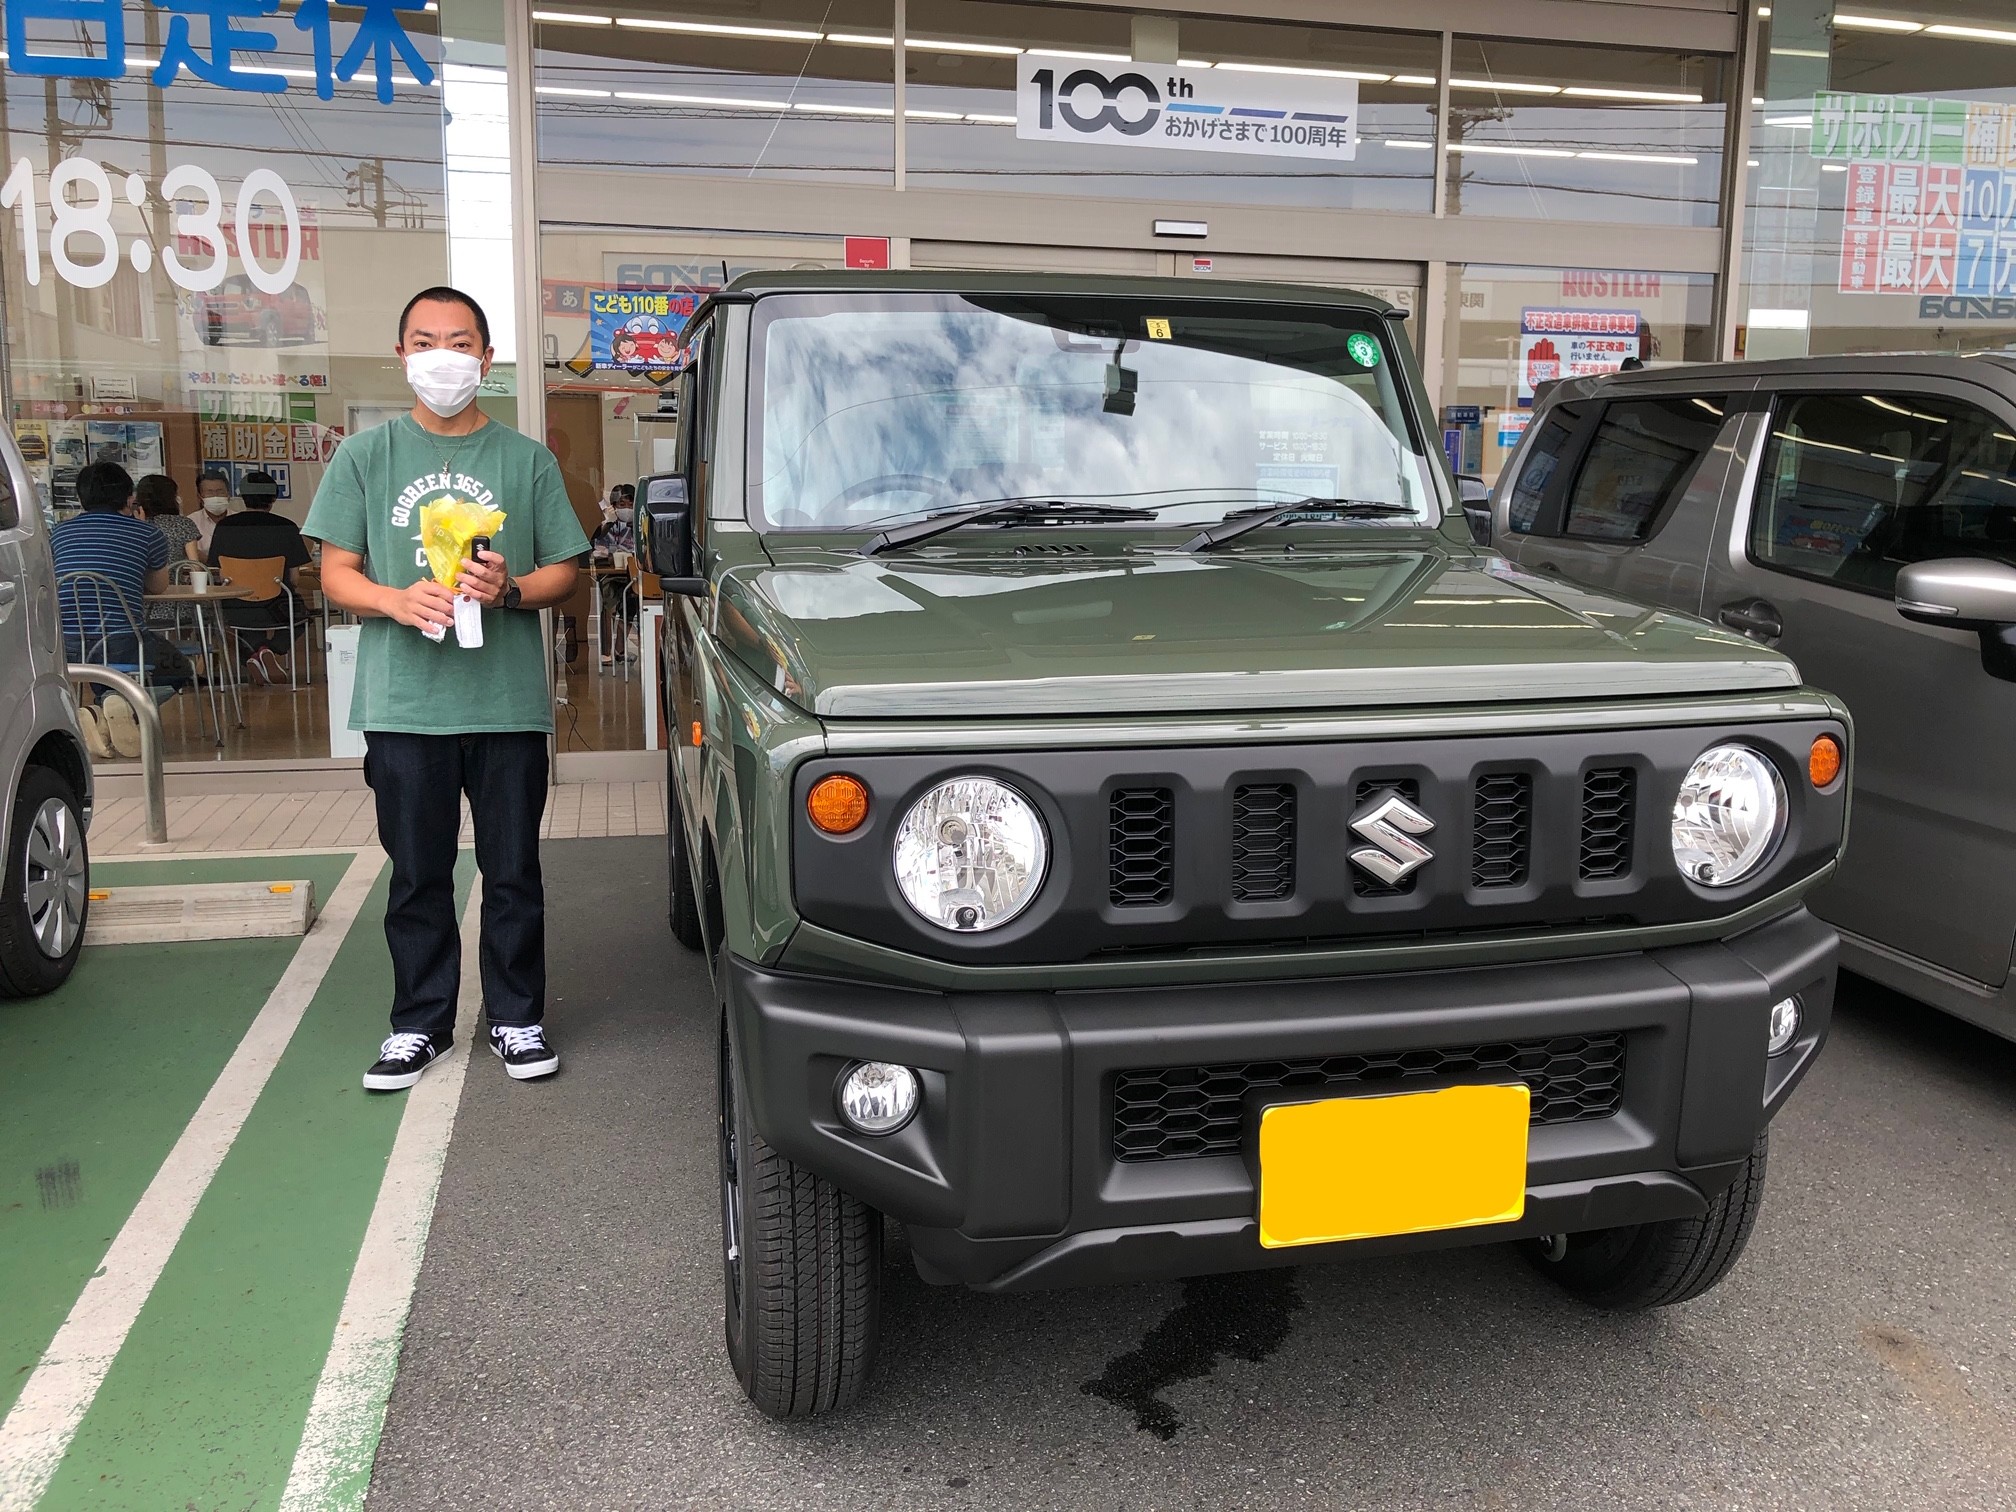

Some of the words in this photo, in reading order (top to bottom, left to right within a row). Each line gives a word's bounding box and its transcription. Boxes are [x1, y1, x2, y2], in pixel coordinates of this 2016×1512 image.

[1165, 116, 1347, 148] おかげさまで100周年
[1855, 166, 1877, 224] 登録車
[1, 157, 302, 295] 18:30
[594, 295, 694, 316] こども110番の店
[1156, 329, 1164, 337] 6
[1259, 442, 1288, 451] サービス
[453, 473, 482, 498] 365
